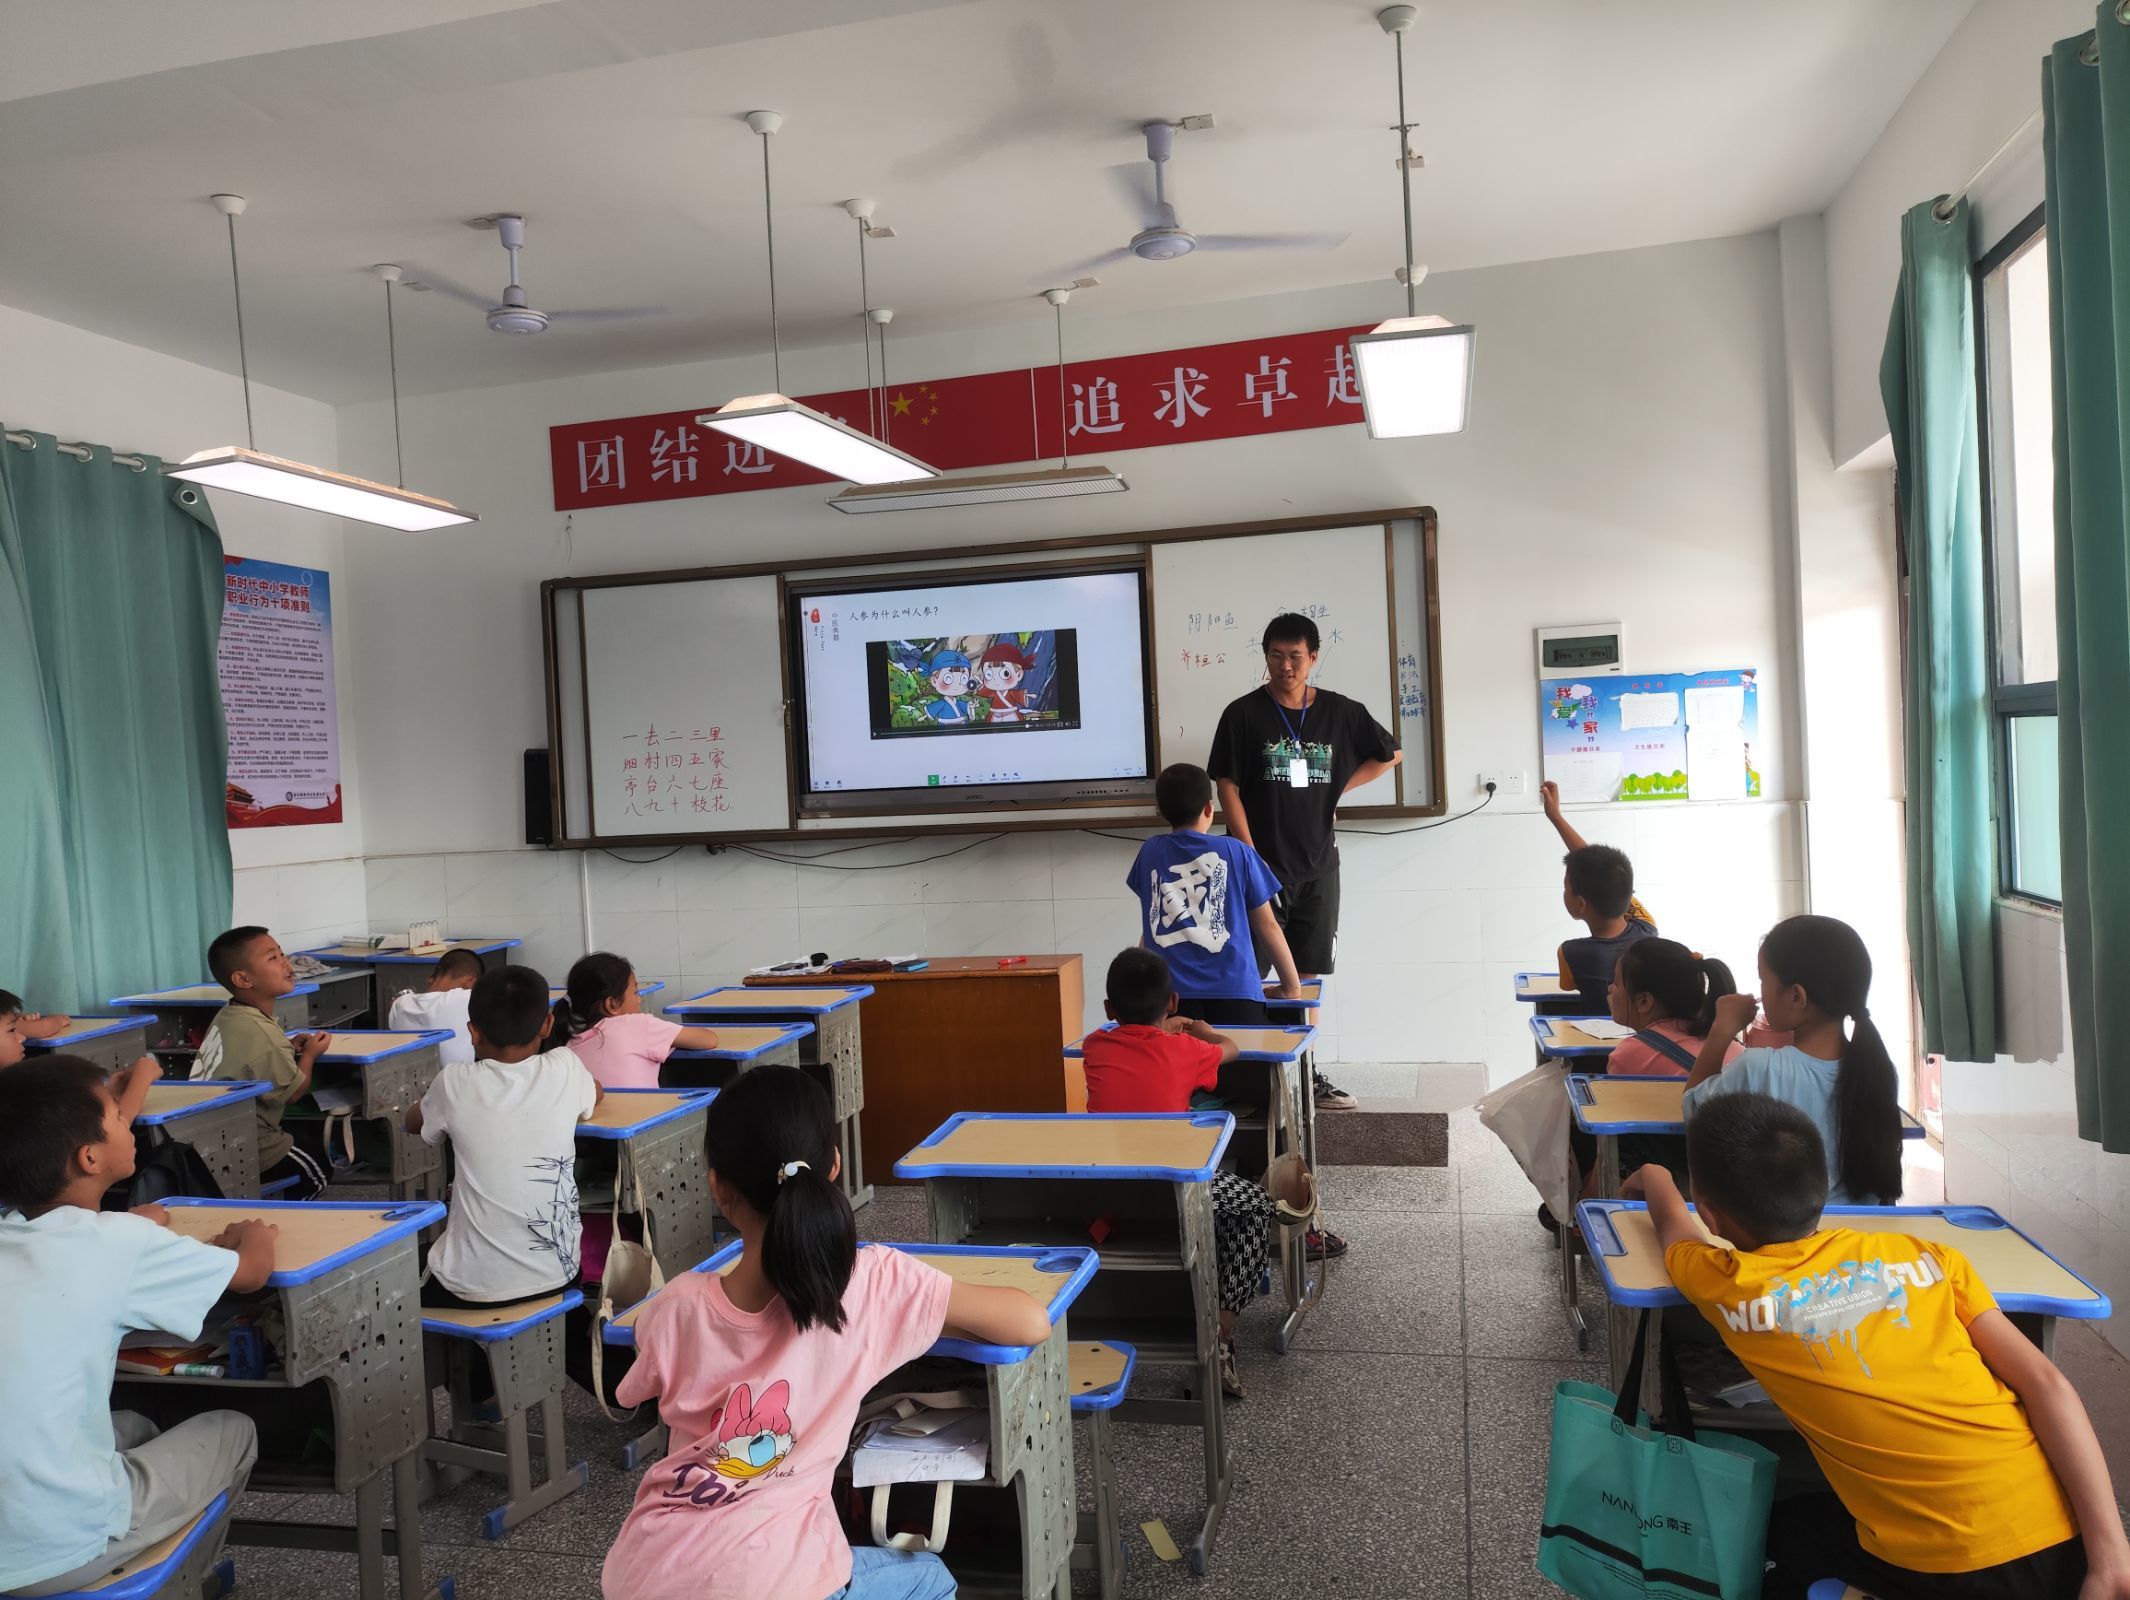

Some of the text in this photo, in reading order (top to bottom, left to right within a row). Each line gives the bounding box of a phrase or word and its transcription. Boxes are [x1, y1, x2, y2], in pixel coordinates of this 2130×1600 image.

[577, 411, 846, 493] 团结进
[226, 574, 309, 597] 新时代中小学教师
[226, 591, 310, 613] 职业行为十项准则
[622, 723, 725, 746] 一去二三里
[624, 772, 729, 797] 亭台六七座
[625, 794, 731, 816] 八九十枝花
[762, 1465, 796, 1481] Duck
[1602, 1490, 1692, 1536] NANONG 南王
